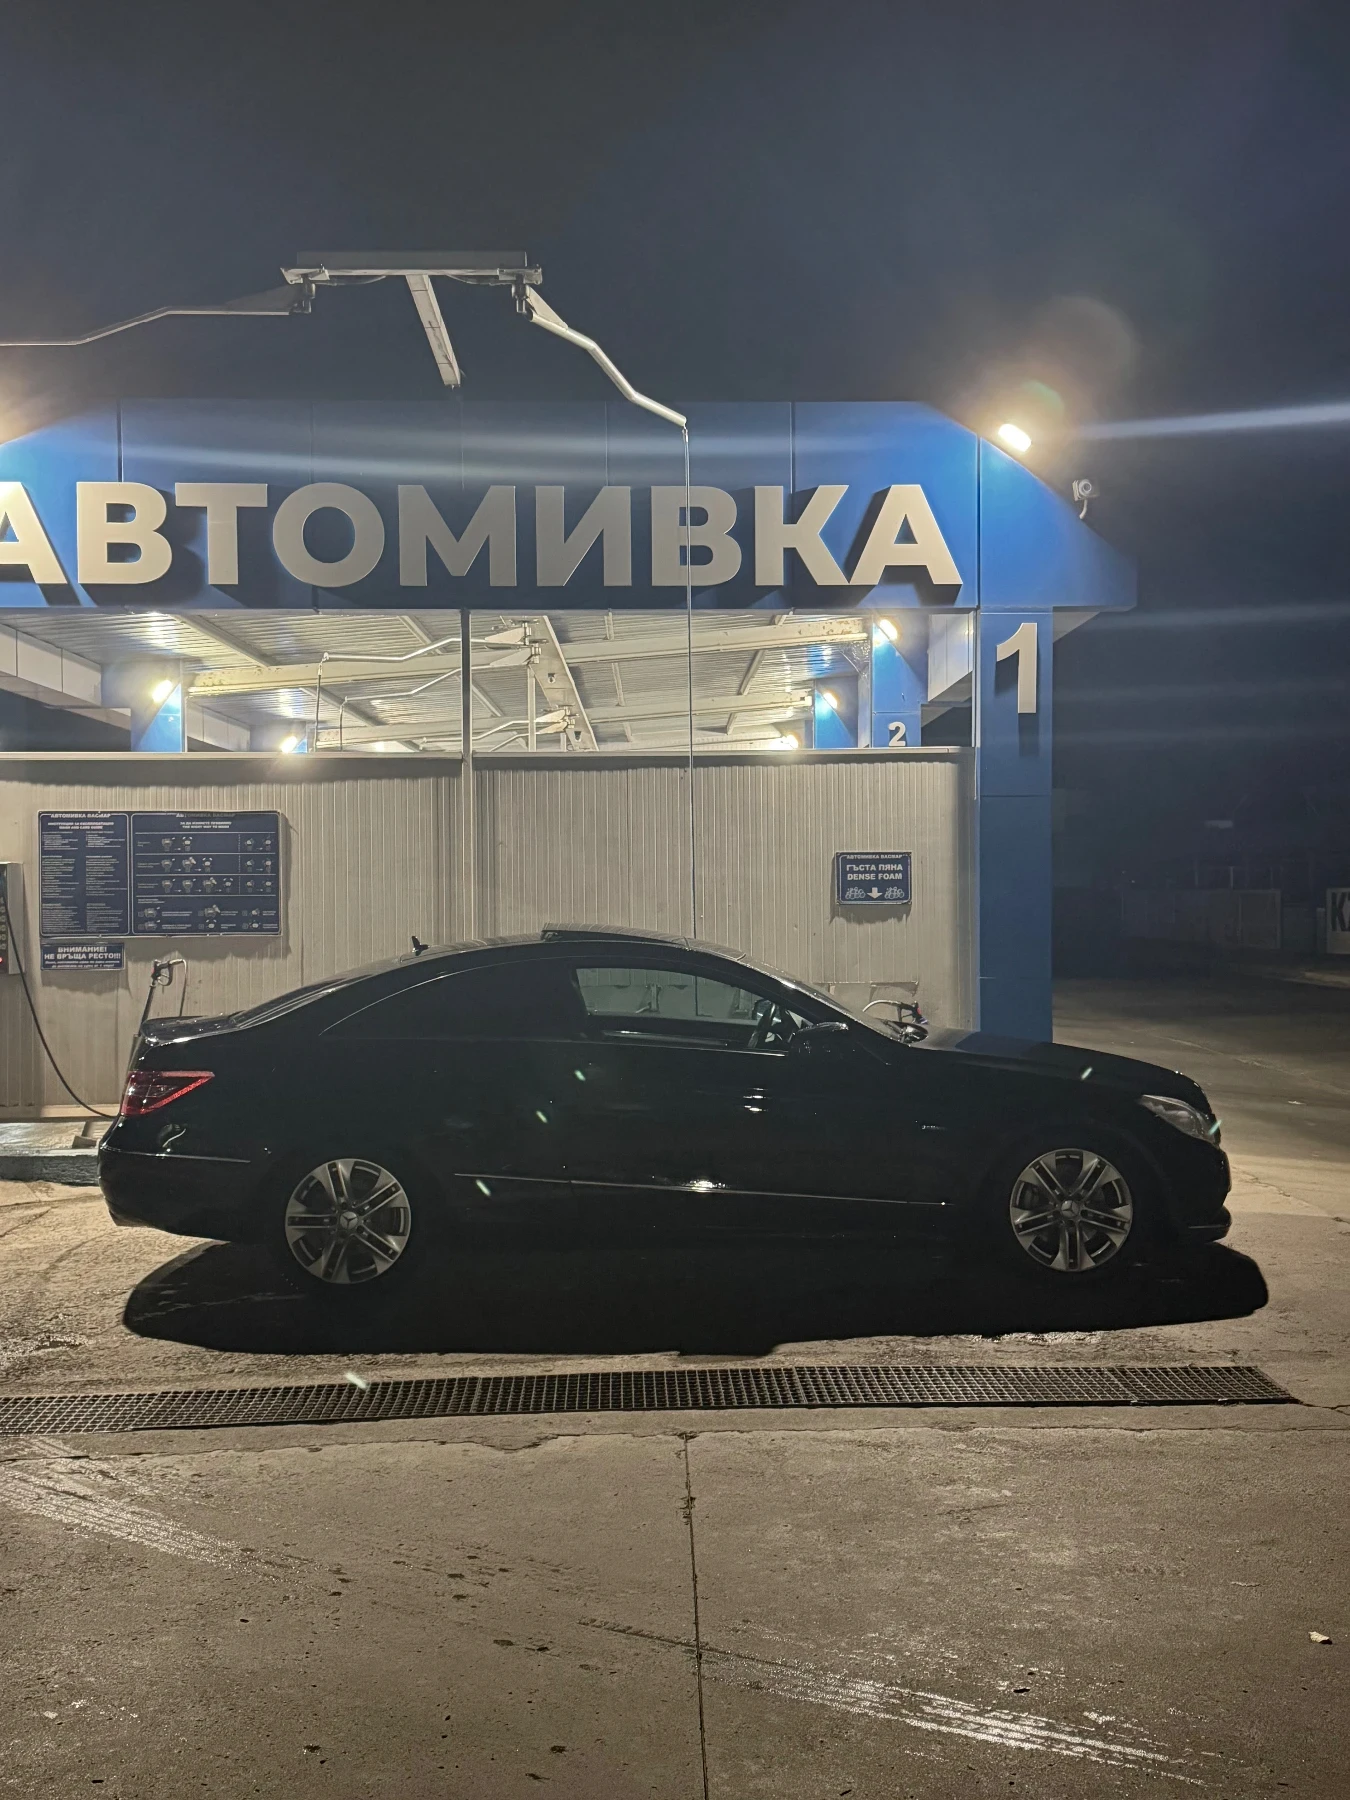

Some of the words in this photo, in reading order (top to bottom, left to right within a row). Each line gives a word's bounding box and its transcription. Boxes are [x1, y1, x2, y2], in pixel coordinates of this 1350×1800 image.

[0, 481, 963, 587] АВТОМИВКА
[996, 622, 1037, 713] 1
[888, 721, 906, 747] 2
